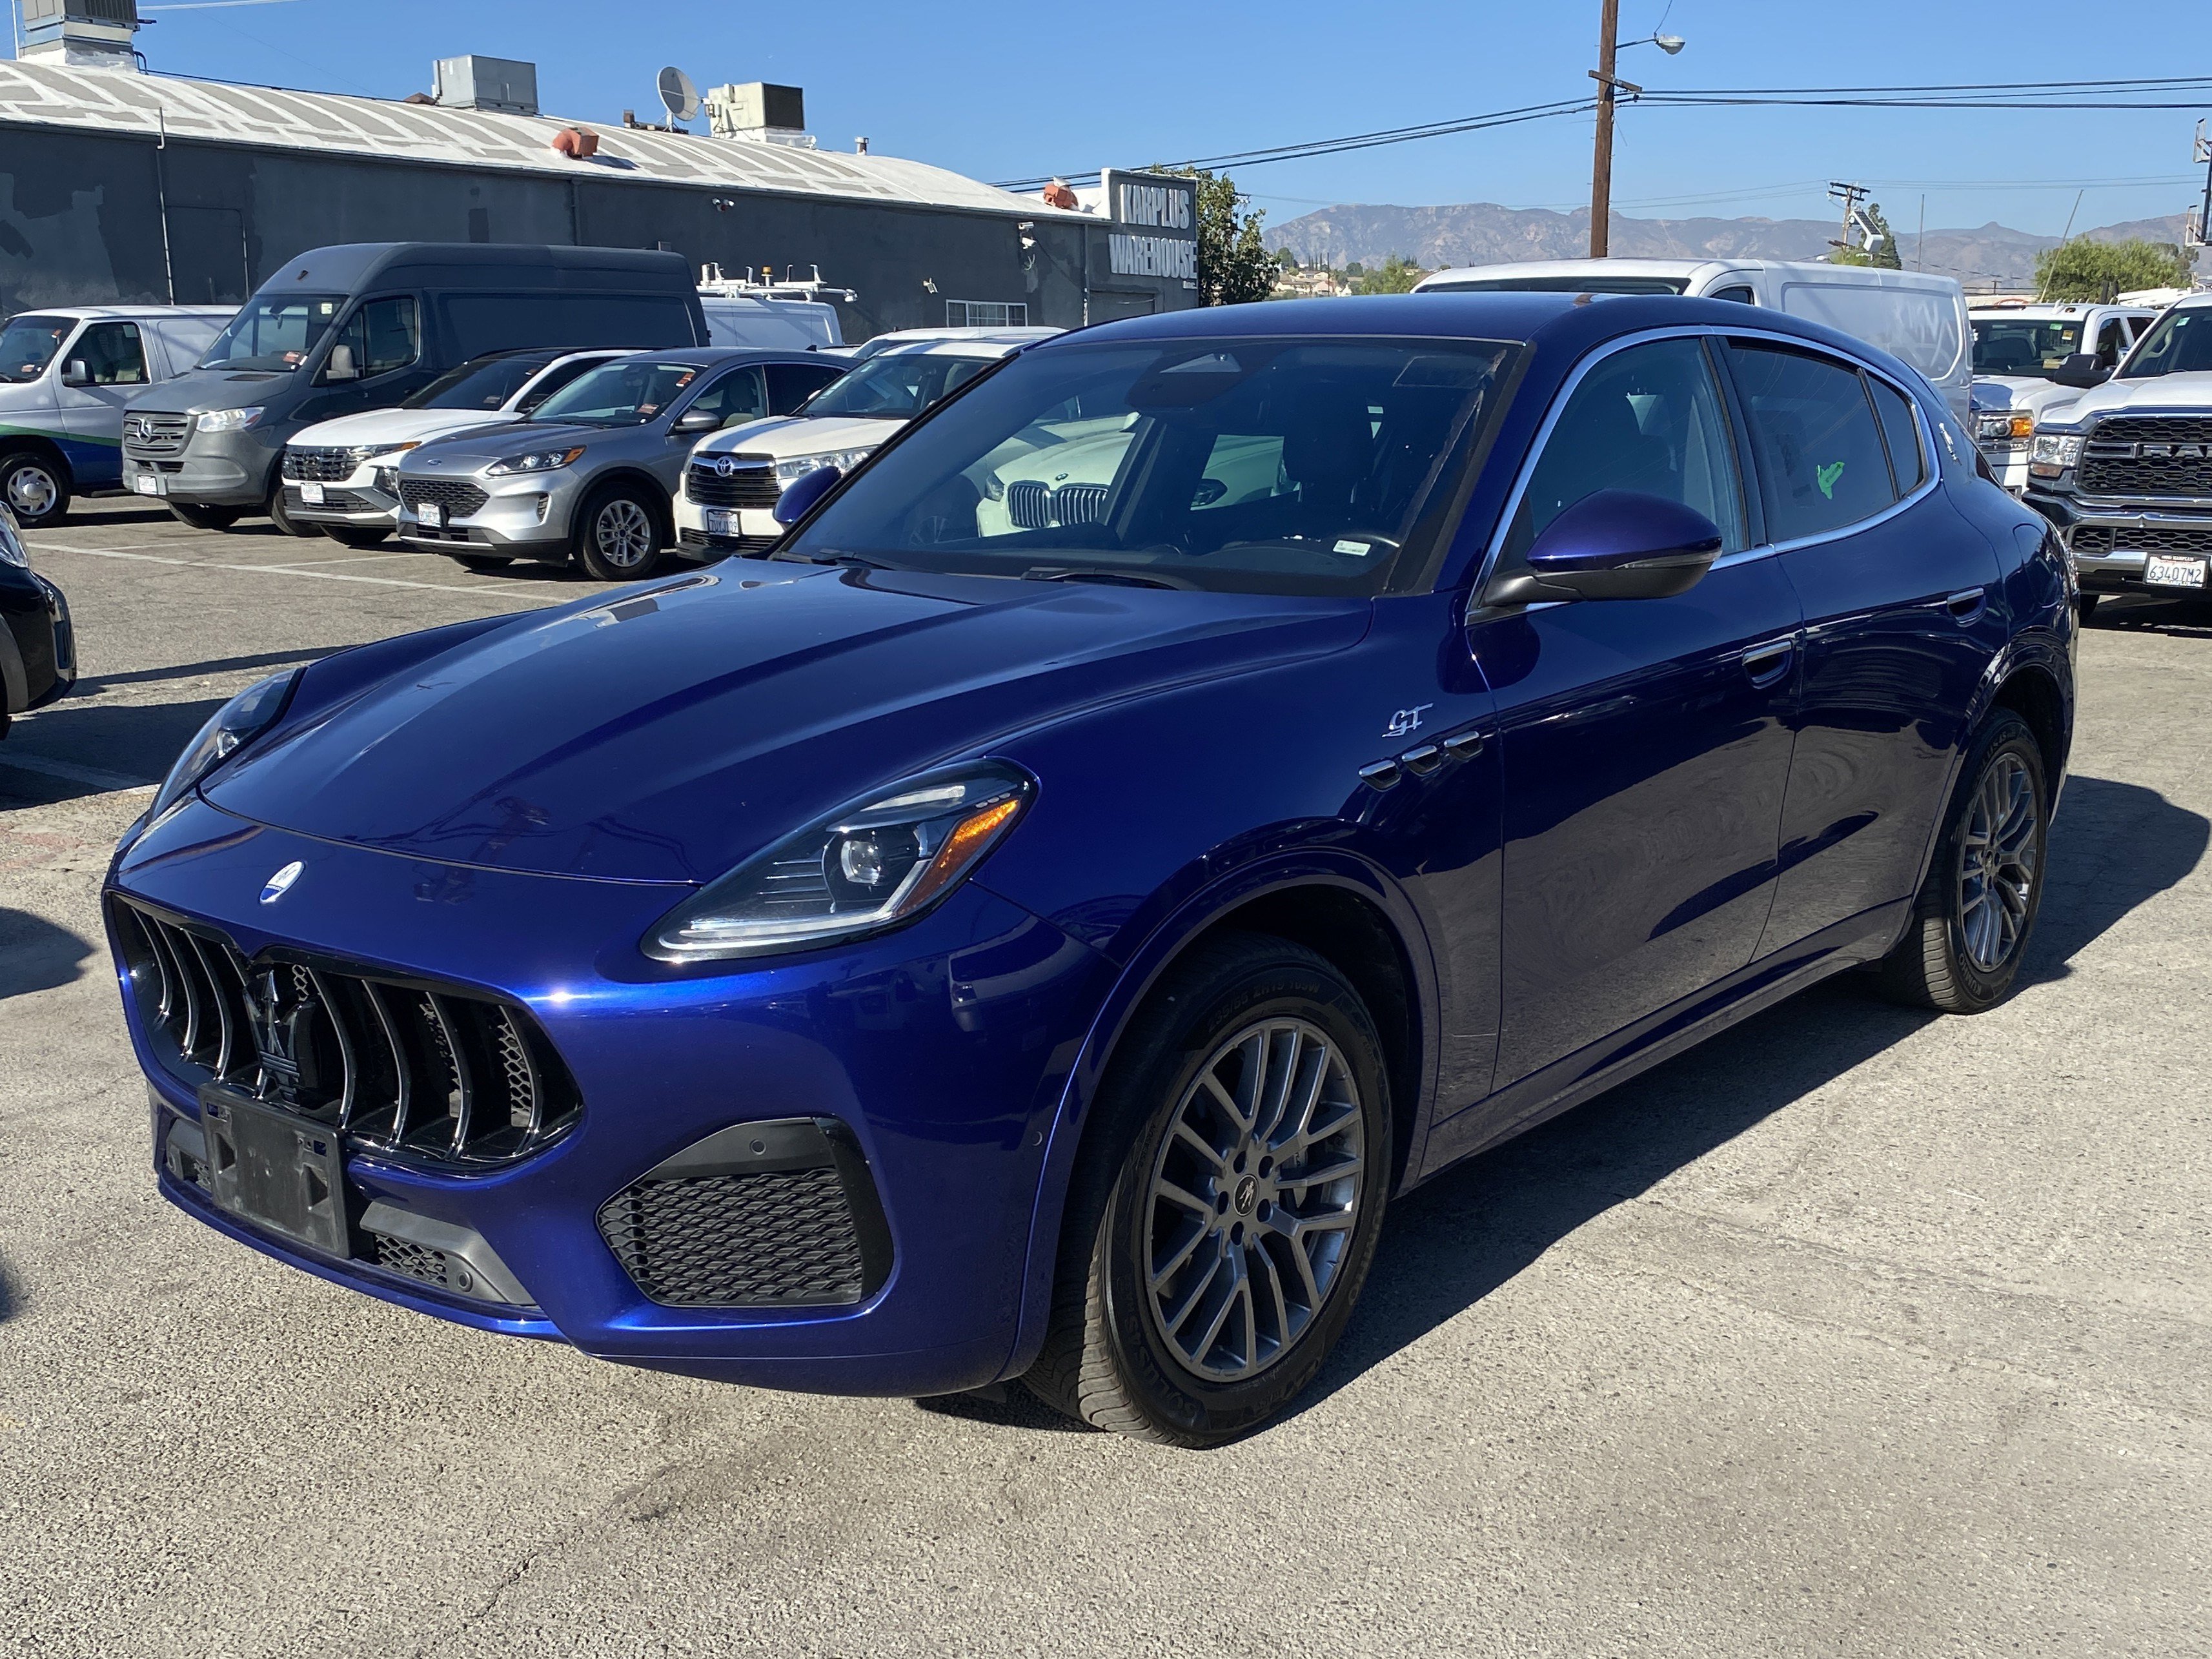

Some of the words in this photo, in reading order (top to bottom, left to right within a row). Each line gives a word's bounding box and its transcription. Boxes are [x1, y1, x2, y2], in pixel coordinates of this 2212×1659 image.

[1120, 183, 1190, 229] KARPLUS
[1108, 234, 1197, 279] WAREHOUSE
[2149, 565, 2202, 583] 63407M2
[1382, 703, 1434, 737] GT
